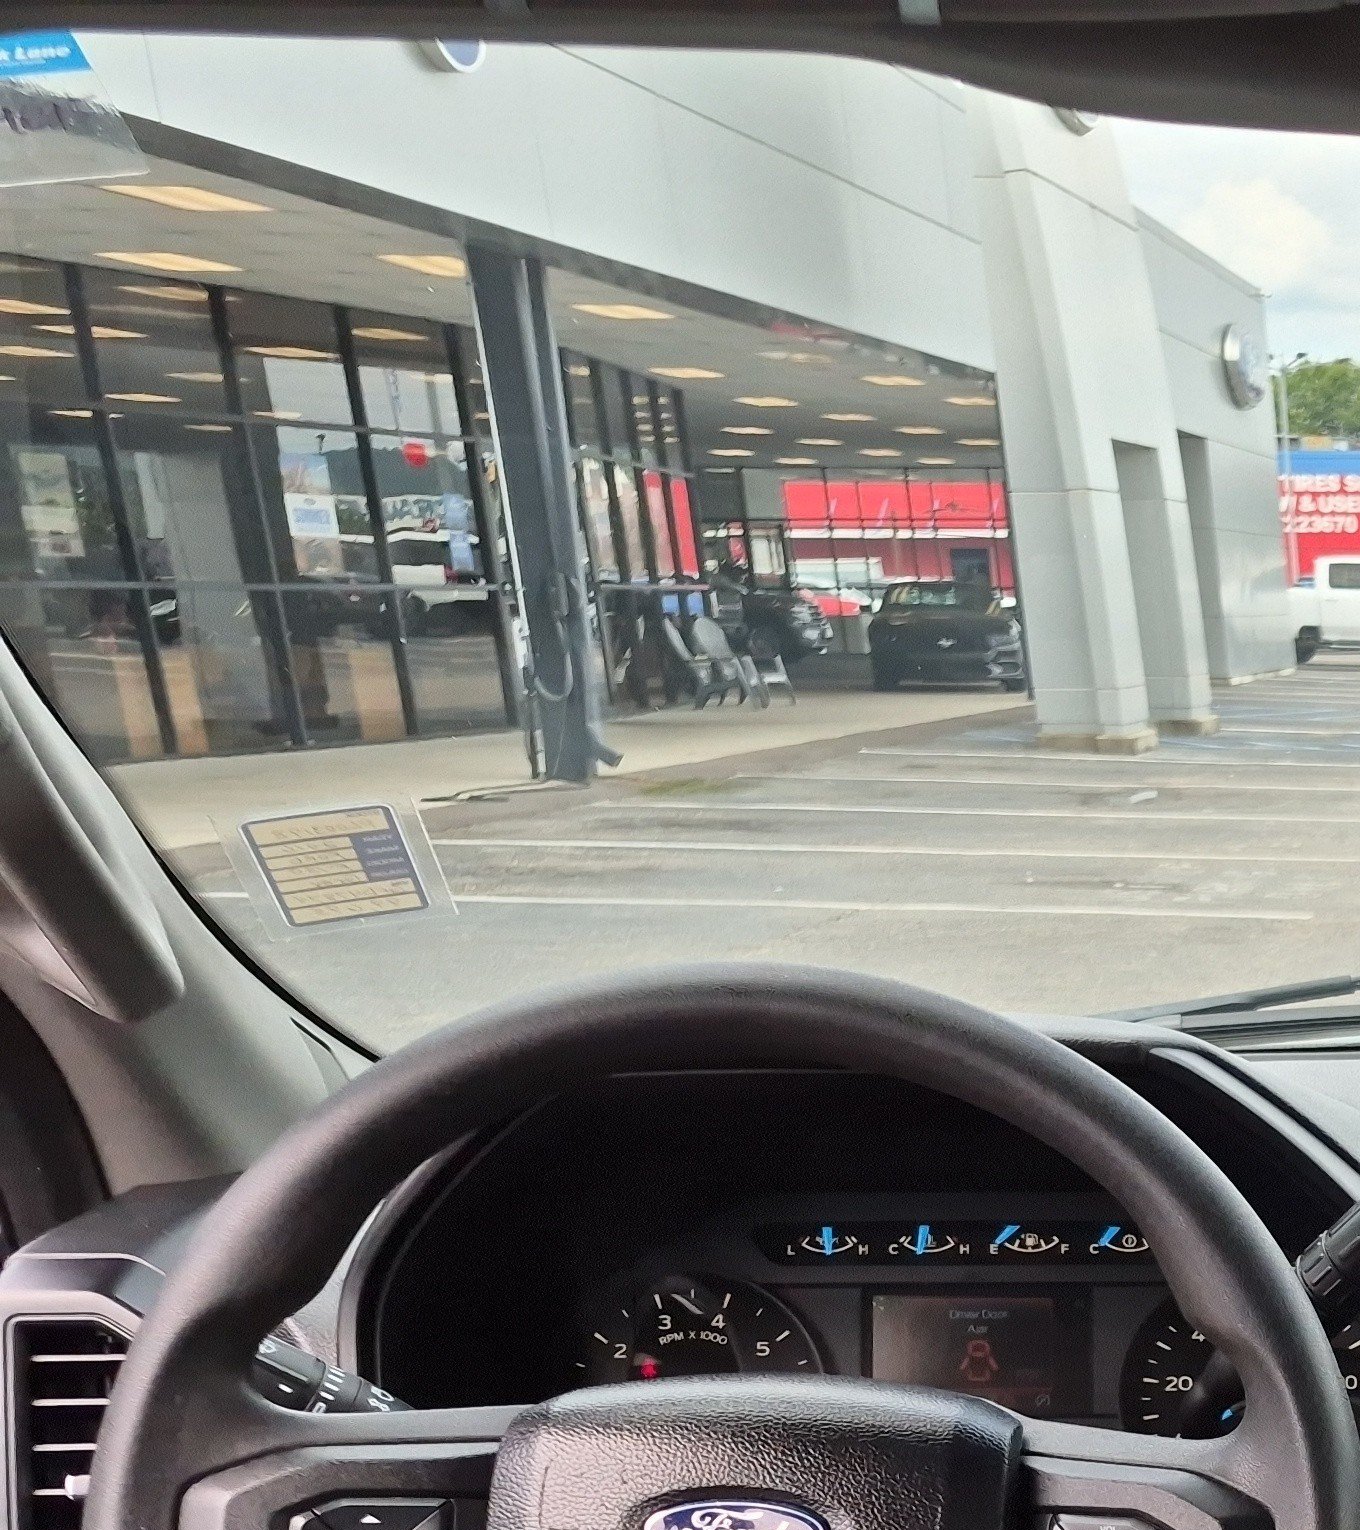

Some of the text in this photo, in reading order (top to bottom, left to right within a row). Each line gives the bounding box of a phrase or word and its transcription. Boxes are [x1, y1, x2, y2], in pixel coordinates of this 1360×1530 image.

[787, 1244, 869, 1256] L H
[888, 1244, 970, 1255] C H
[989, 1243, 1070, 1255] E F
[1089, 1243, 1099, 1255] C
[657, 1315, 672, 1330] 3
[710, 1314, 726, 1329] 4
[658, 1331, 685, 1346] RPM
[699, 1330, 728, 1345] 1000
[613, 1343, 628, 1359] 2
[755, 1341, 771, 1357] 5
[1164, 1375, 1194, 1392] 20
